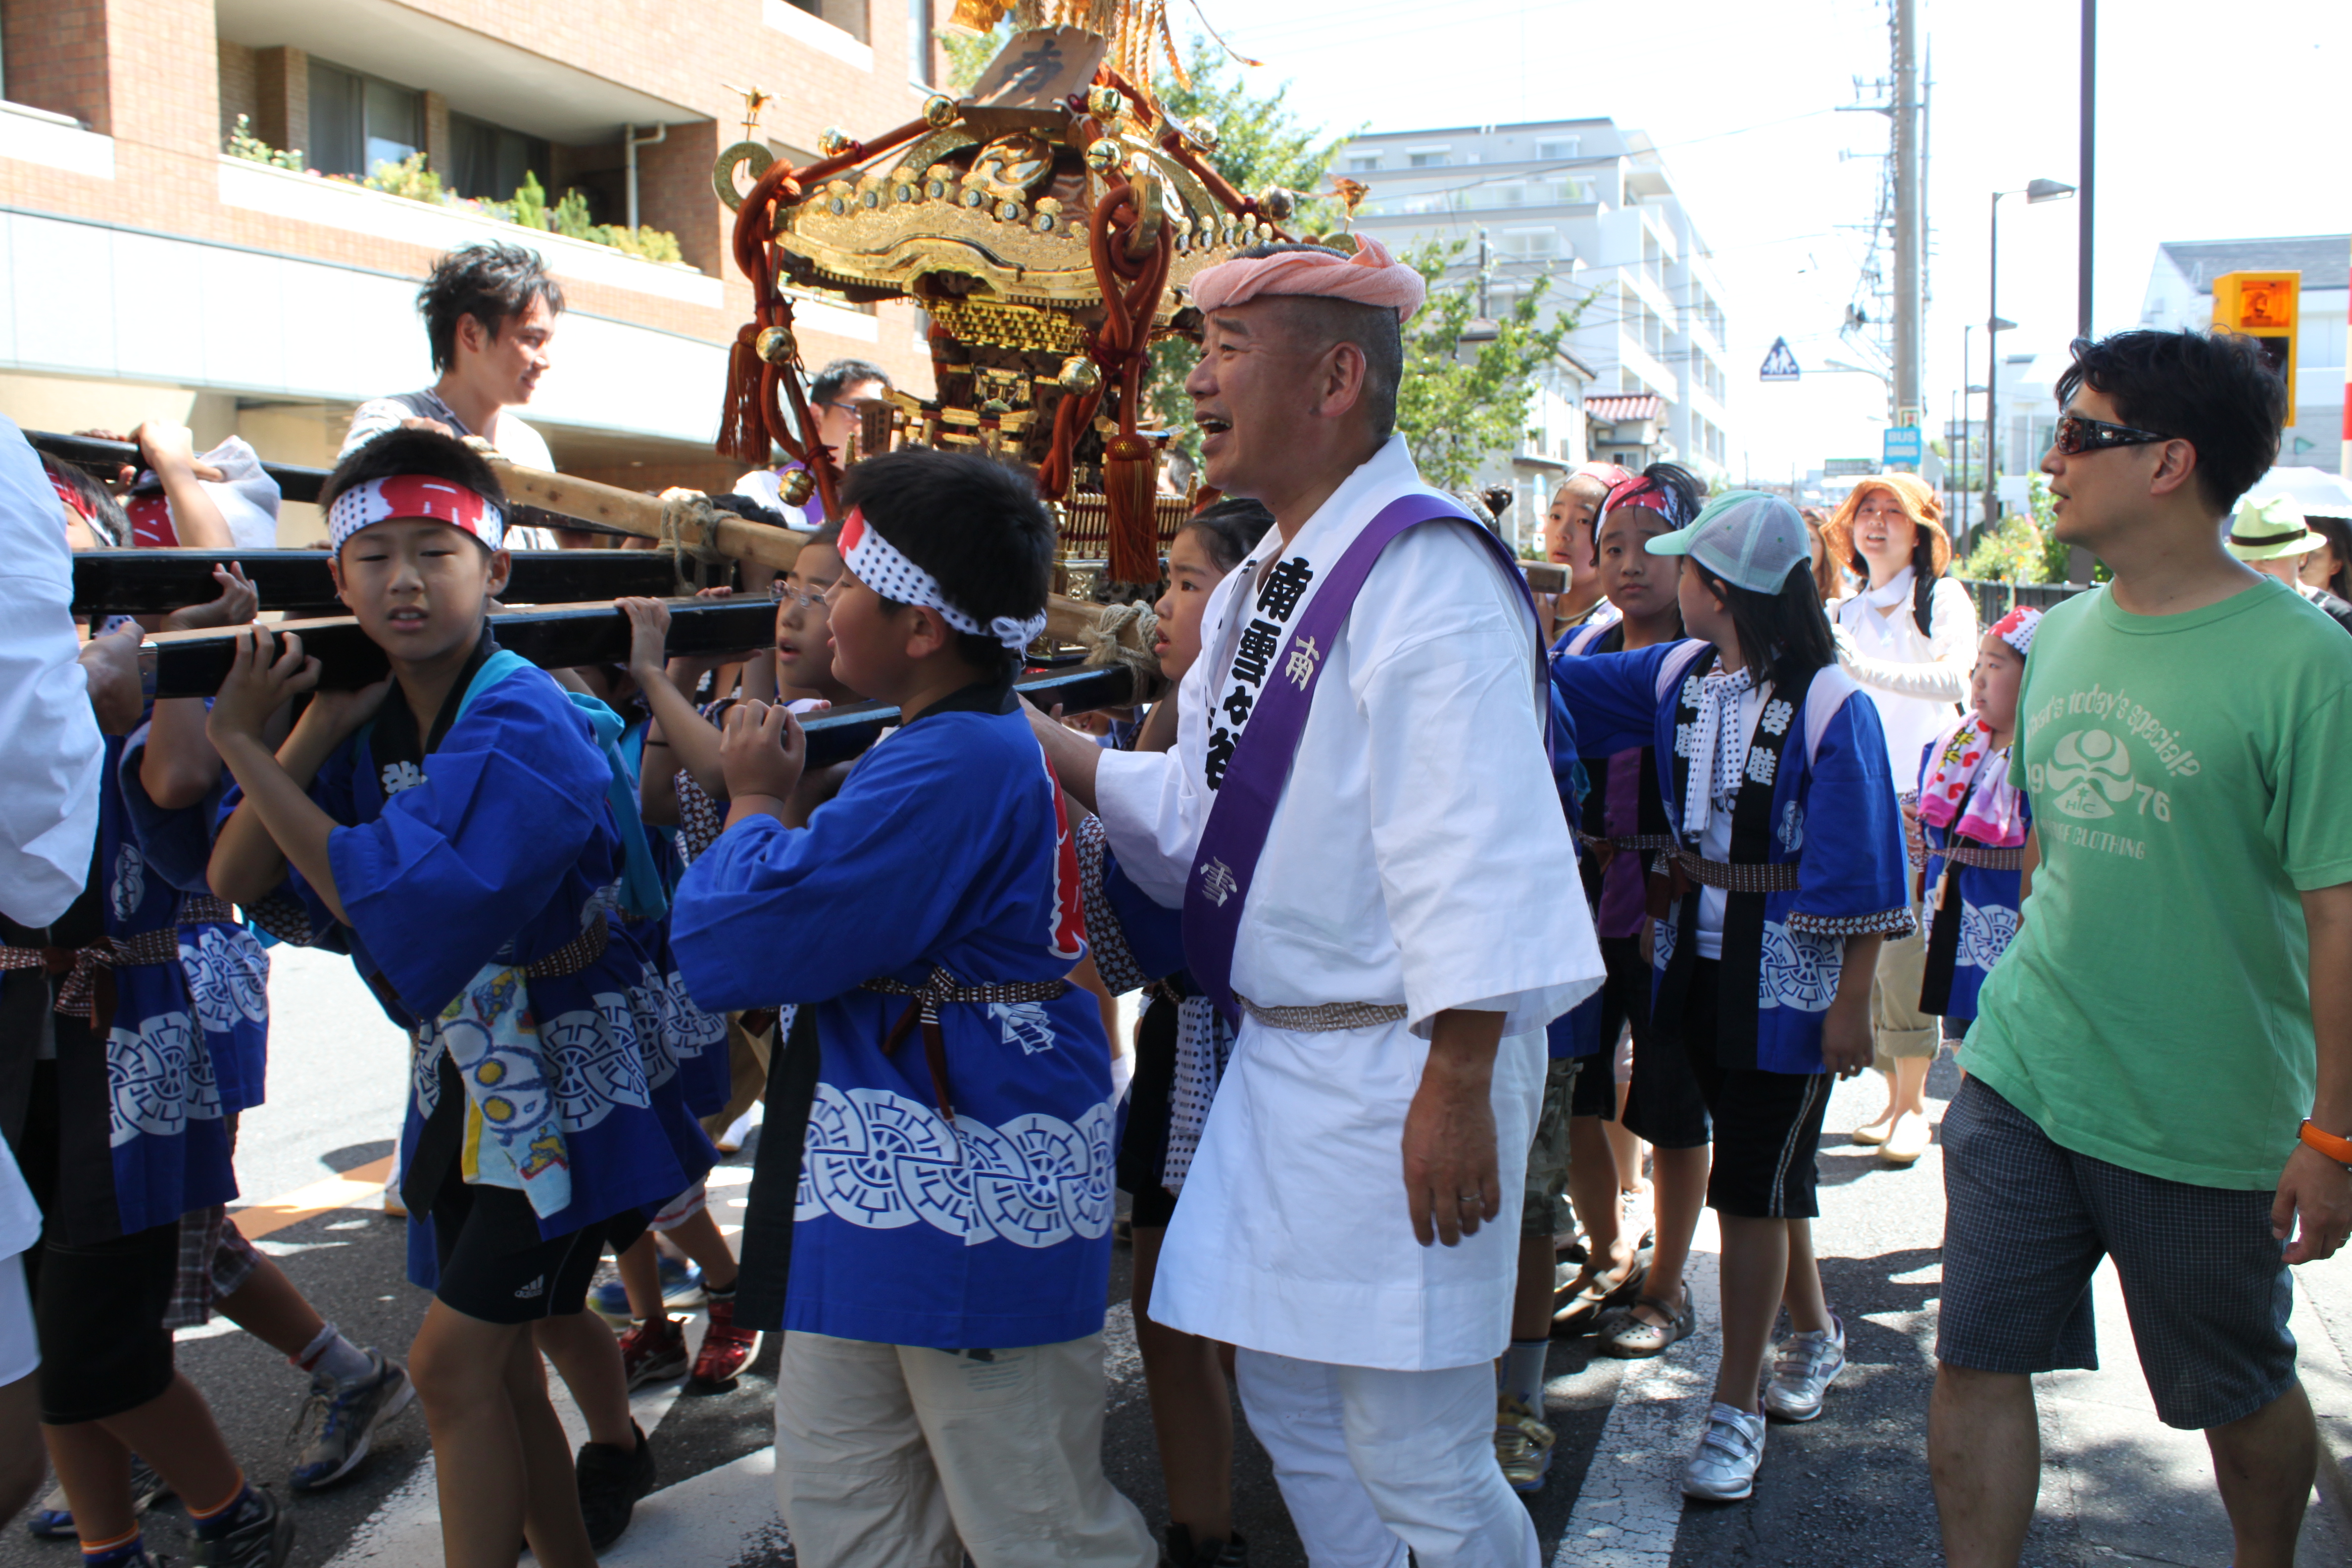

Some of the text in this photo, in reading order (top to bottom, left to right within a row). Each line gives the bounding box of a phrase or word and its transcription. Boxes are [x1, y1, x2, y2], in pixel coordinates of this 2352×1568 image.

[1887, 431, 1916, 443] BUS
[2026, 683, 2201, 777] hat's today's special?
[2136, 783, 2170, 823] 76
[2072, 826, 2146, 860] CLOTHING
